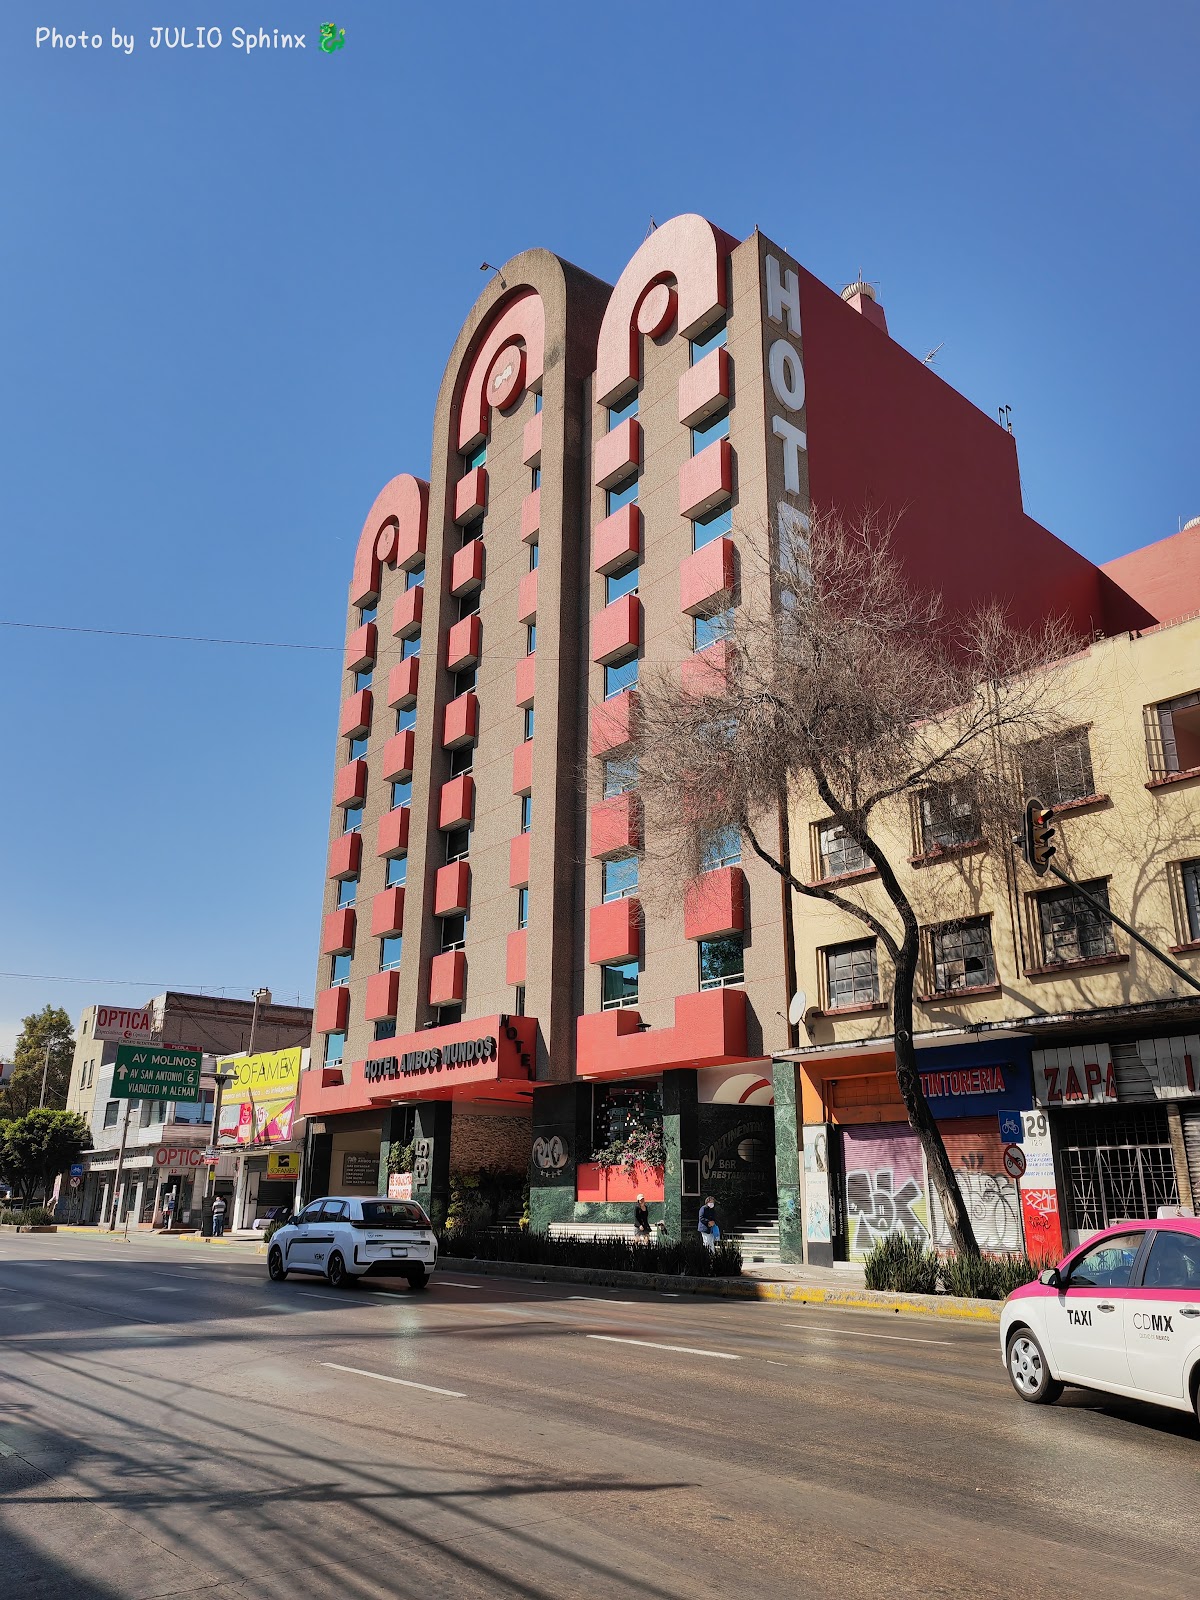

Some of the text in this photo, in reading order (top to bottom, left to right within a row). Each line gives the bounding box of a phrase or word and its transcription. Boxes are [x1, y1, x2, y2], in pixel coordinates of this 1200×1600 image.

[97, 1009, 150, 1030] OPTICA
[131, 1053, 197, 1067] AV MOLINOS
[364, 1036, 495, 1079] HOTEL AMBOS MUNDOS
[130, 1069, 182, 1081] AV SAN ANTONIO
[187, 1073, 194, 1082] 6
[233, 1056, 296, 1085] SOFAMEX
[128, 1083, 195, 1096] VIADUCTO M ALEMAN
[919, 1066, 1006, 1098] TINTORERIA
[719, 1160, 736, 1169] BAR
[1067, 1309, 1092, 1326] TAXI
[1133, 1312, 1174, 1333] CDMX
